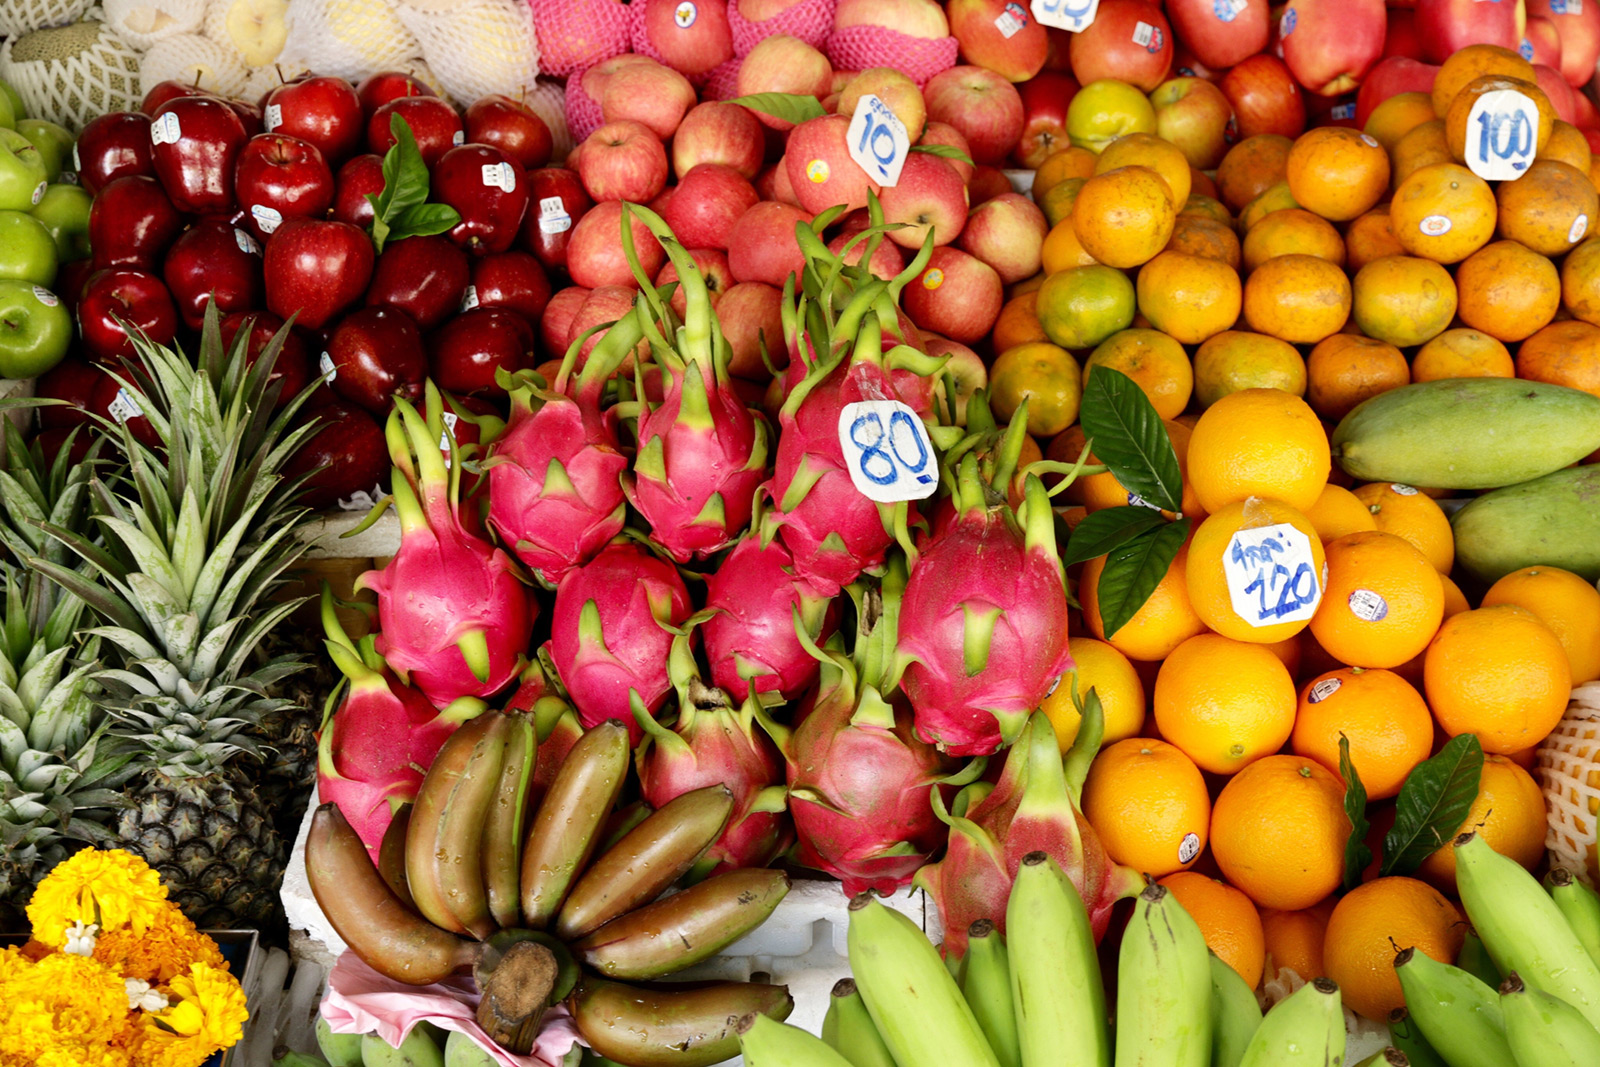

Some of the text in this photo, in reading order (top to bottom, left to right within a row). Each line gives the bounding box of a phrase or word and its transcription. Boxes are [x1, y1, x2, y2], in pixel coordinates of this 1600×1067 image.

[859, 112, 896, 166] 10
[1477, 108, 1532, 164] 100
[850, 411, 928, 486] 80
[1244, 562, 1317, 620] 120
